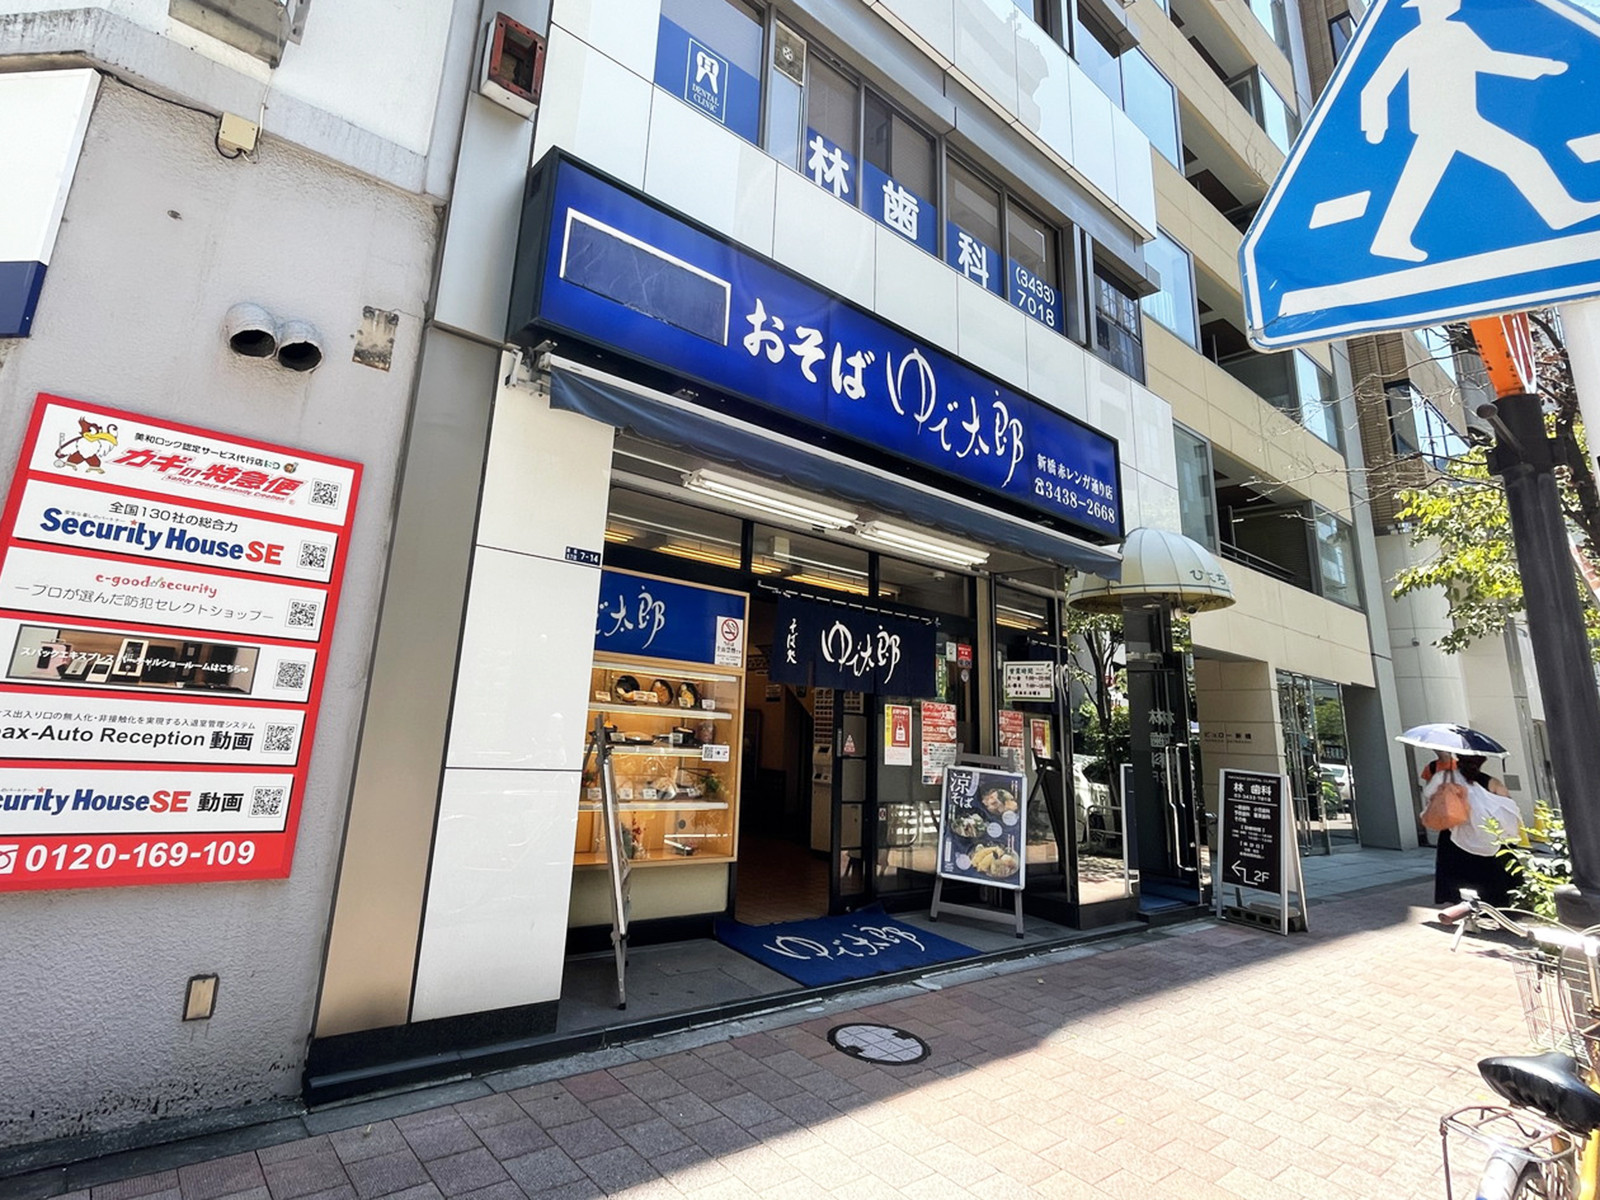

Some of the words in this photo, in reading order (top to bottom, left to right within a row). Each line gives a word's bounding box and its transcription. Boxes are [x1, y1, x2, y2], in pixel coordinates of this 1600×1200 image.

[692, 83, 719, 107] DENTAL
[693, 93, 717, 113] CLINIC
[1015, 266, 1055, 306] (3433)
[1017, 289, 1055, 327] 7018
[743, 298, 876, 400] おそば
[887, 348, 1024, 488] ゆで太郎
[113, 449, 304, 496] カギの特急便
[40, 507, 164, 550] Security
[109, 501, 239, 533] 全国130社の総合力
[159, 580, 218, 599] security
[821, 620, 901, 684] ゆで太郎
[0, 725, 94, 742] ax-Auto
[100, 727, 205, 748] Reception
[209, 731, 255, 751] 動画
[950, 772, 972, 794] 涼
[197, 791, 244, 813] 動画
[951, 792, 974, 809] そば
[25, 840, 256, 872] 0120-169-109
[1254, 870, 1270, 883] 2F
